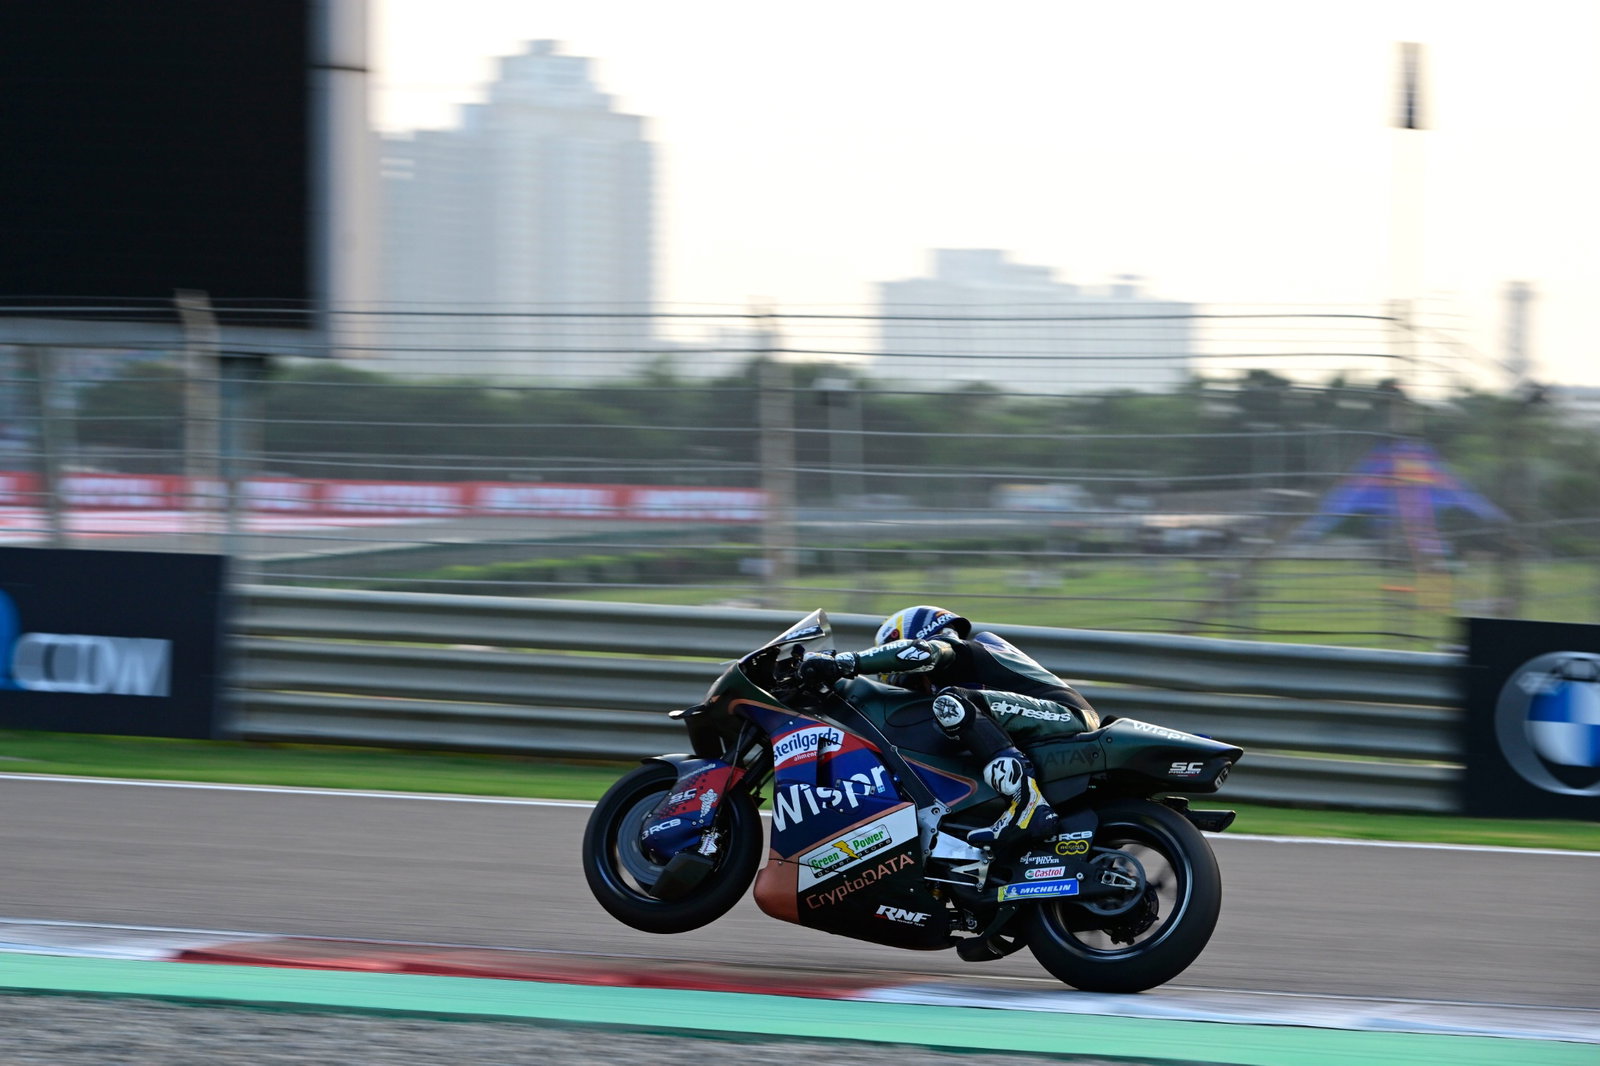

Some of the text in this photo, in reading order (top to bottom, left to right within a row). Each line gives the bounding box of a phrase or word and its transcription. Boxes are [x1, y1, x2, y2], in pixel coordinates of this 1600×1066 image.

[916, 612, 953, 640] SHARK
[990, 700, 1071, 722] alpinestars
[1169, 762, 1204, 771] SC
[772, 765, 886, 832] Wispr
[1058, 831, 1093, 841] RCB
[811, 830, 884, 870] Green Power
[806, 854, 915, 910] CryptoDATA
[1034, 868, 1063, 878] Castrol
[1020, 884, 1072, 894] MICHELIN
[875, 904, 932, 922] RNF
